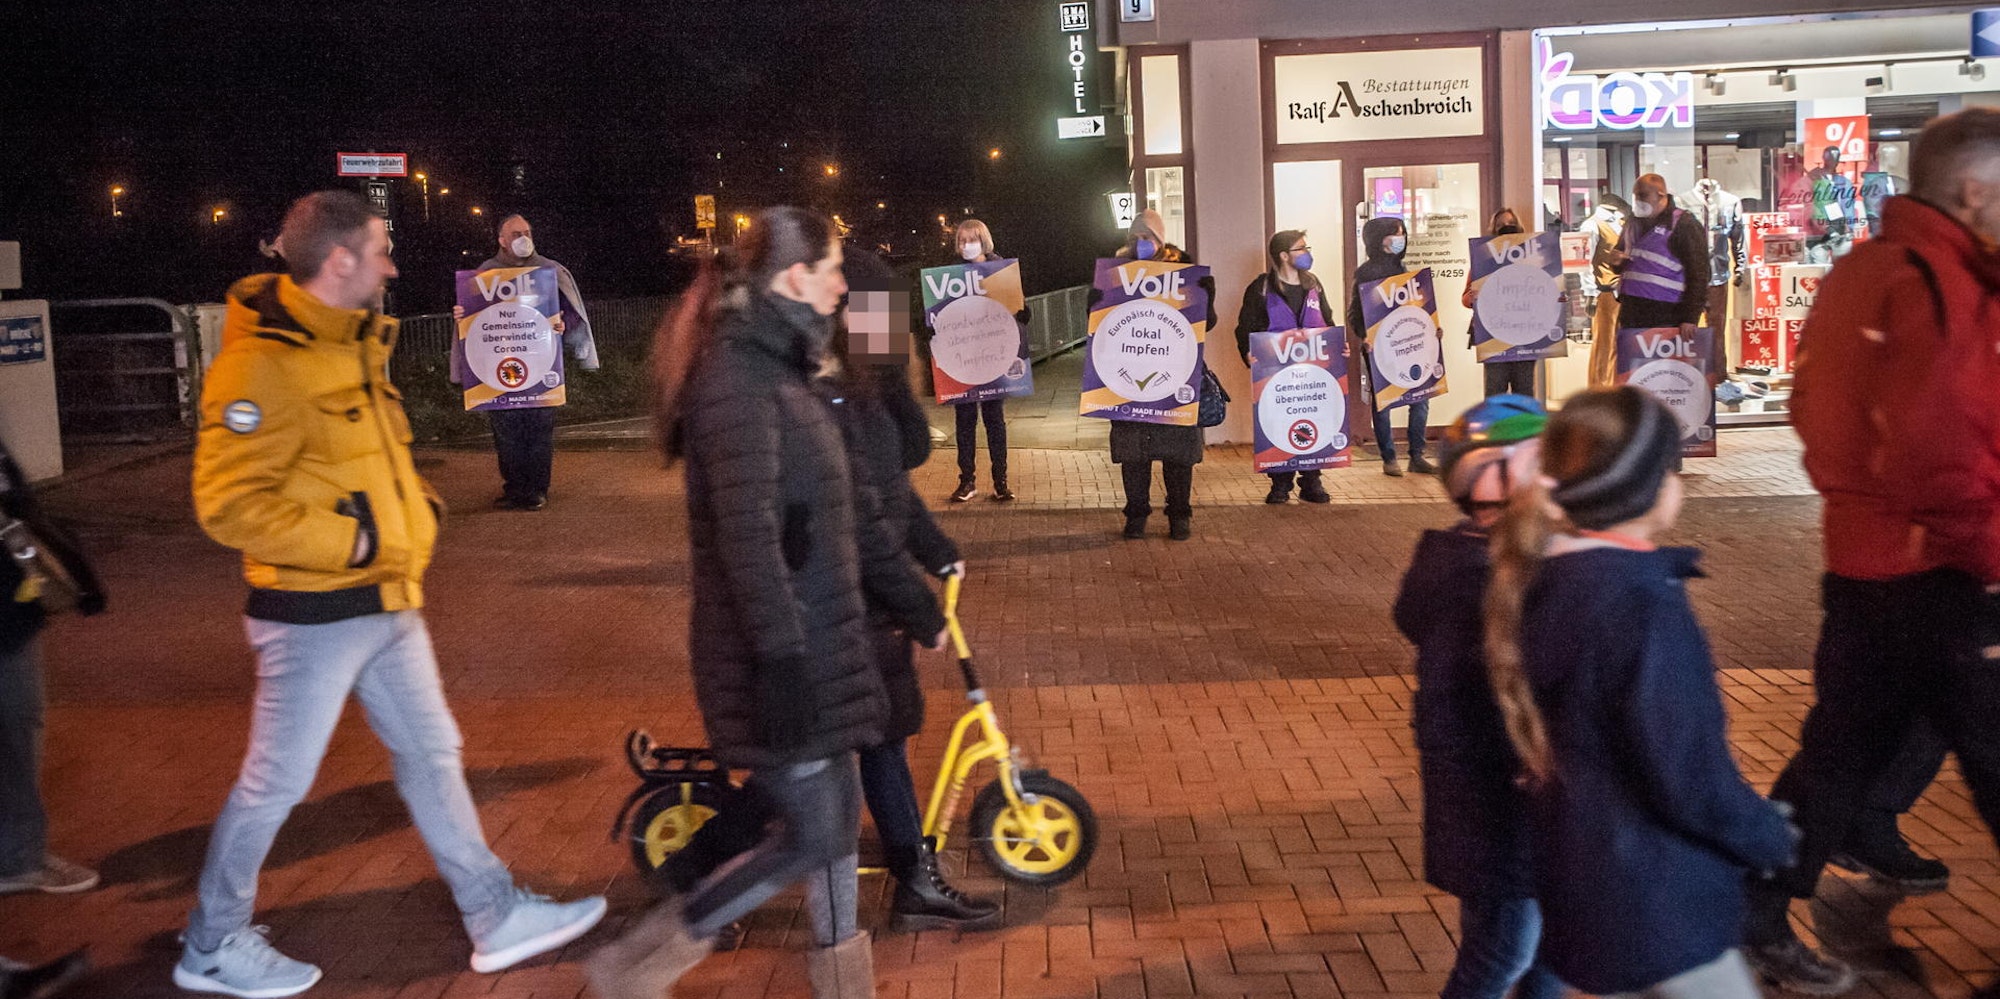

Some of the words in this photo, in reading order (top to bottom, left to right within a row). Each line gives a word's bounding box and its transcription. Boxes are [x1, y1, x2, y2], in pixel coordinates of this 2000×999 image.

[1069, 34, 1086, 113] HOTEL
[1363, 78, 1469, 95] Bestattungen
[1289, 102, 1326, 123] Ralf
[1328, 80, 1472, 117] Aschenbroich
[342, 158, 402, 167] Feuerwehrzufahrt
[1486, 239, 1544, 264] Volt
[1431, 269, 1464, 278] 5/4259
[475, 274, 536, 301] Volt
[925, 270, 988, 300] Volt
[1118, 266, 1185, 301] Volt
[1377, 278, 1423, 308] Volt
[1785, 296, 1816, 307] SAL
[482, 320, 536, 331] Gemeinsinn
[1108, 309, 1155, 336] Europäisch
[1157, 313, 1186, 339] denken
[1745, 320, 1777, 331] SALE
[482, 332, 537, 343] überwindet
[1131, 327, 1161, 340] lokal
[494, 345, 527, 354] Corona
[1121, 343, 1169, 356] Impfen!
[1270, 334, 1329, 364] Volt
[1636, 334, 1697, 358] Volt
[1275, 381, 1327, 392] Gemeinsinn
[1275, 393, 1327, 404] überwindet
[1666, 397, 1686, 407] fen!
[1286, 406, 1318, 415] Corona
